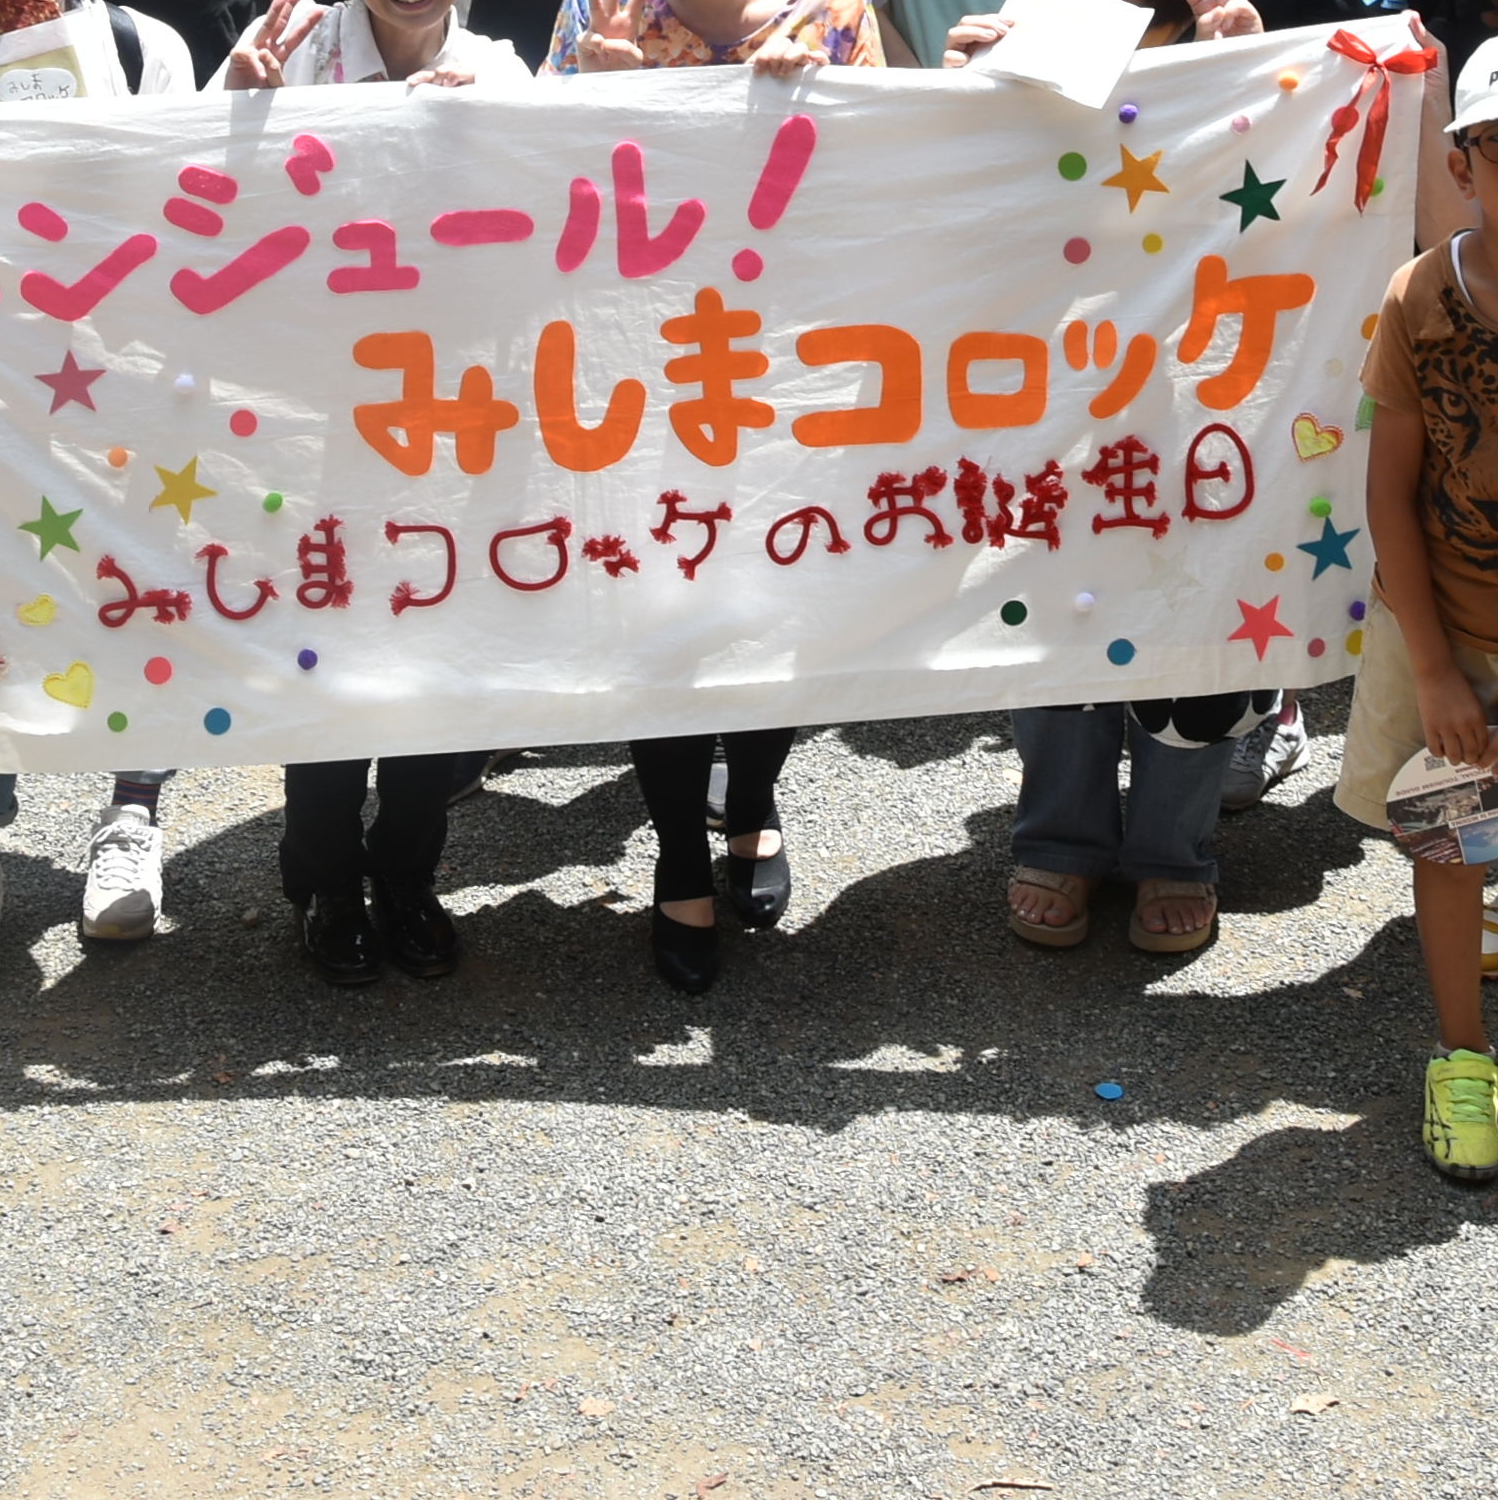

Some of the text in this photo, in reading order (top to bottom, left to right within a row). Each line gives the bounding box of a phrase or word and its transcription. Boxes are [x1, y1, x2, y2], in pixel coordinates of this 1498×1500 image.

[352, 254, 1315, 476] みしまコロッケ
[96, 422, 1255, 629] みしまコロッケのお誕生日
[1394, 784, 1420, 797] GUIDE
[1421, 774, 1458, 790] TOURISM
